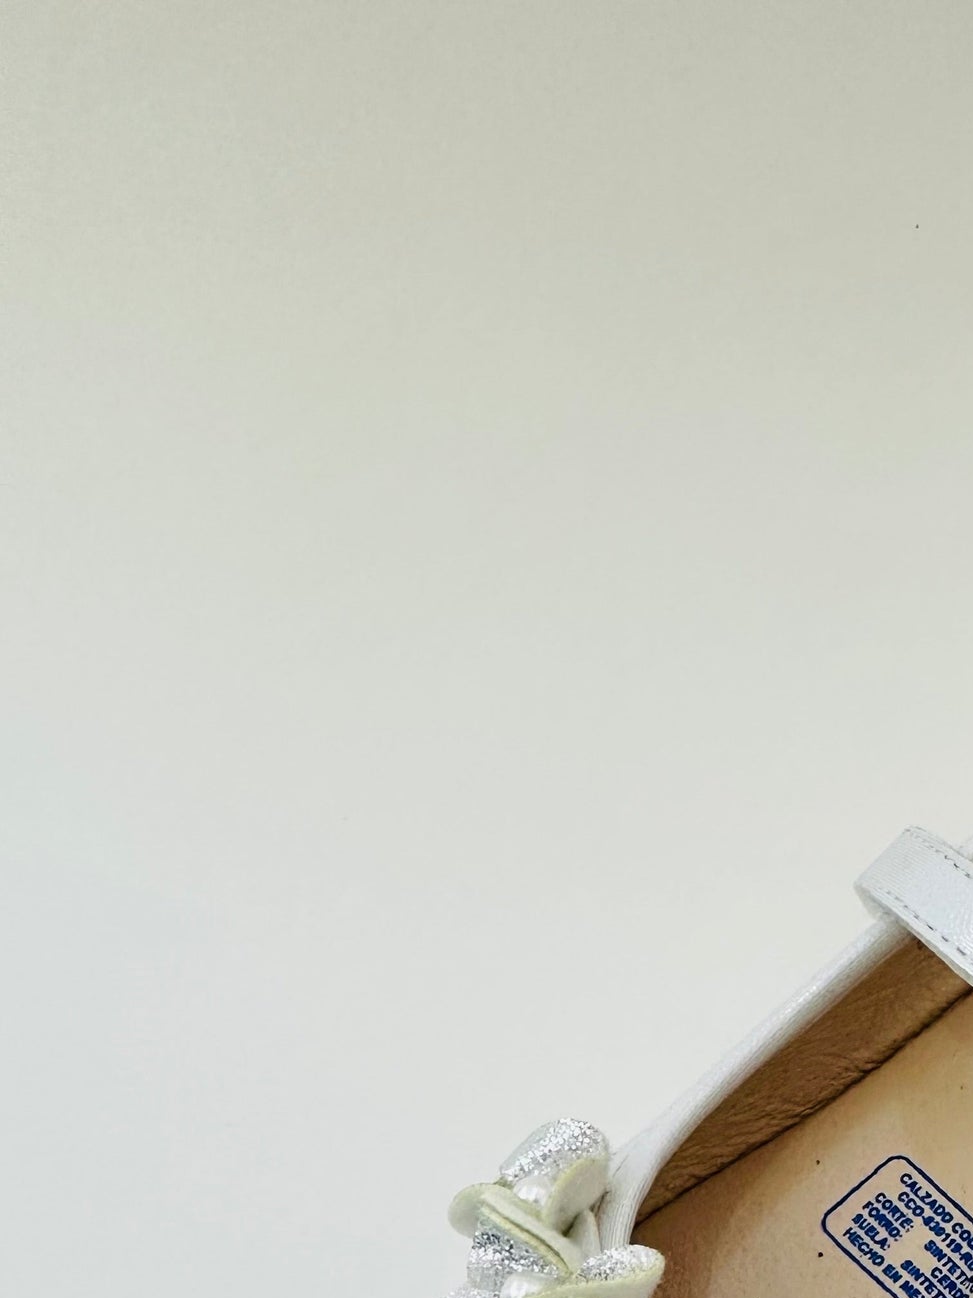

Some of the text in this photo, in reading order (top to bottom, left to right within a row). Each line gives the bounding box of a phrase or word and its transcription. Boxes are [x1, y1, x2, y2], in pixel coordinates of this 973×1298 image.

[874, 1192, 914, 1233] CORTE:
[900, 1173, 954, 1223] CALZADO
[851, 1213, 891, 1250] SUELA:
[862, 1200, 903, 1242] FORRO:
[842, 1226, 885, 1267] HECHO
[882, 1263, 904, 1283] EN
